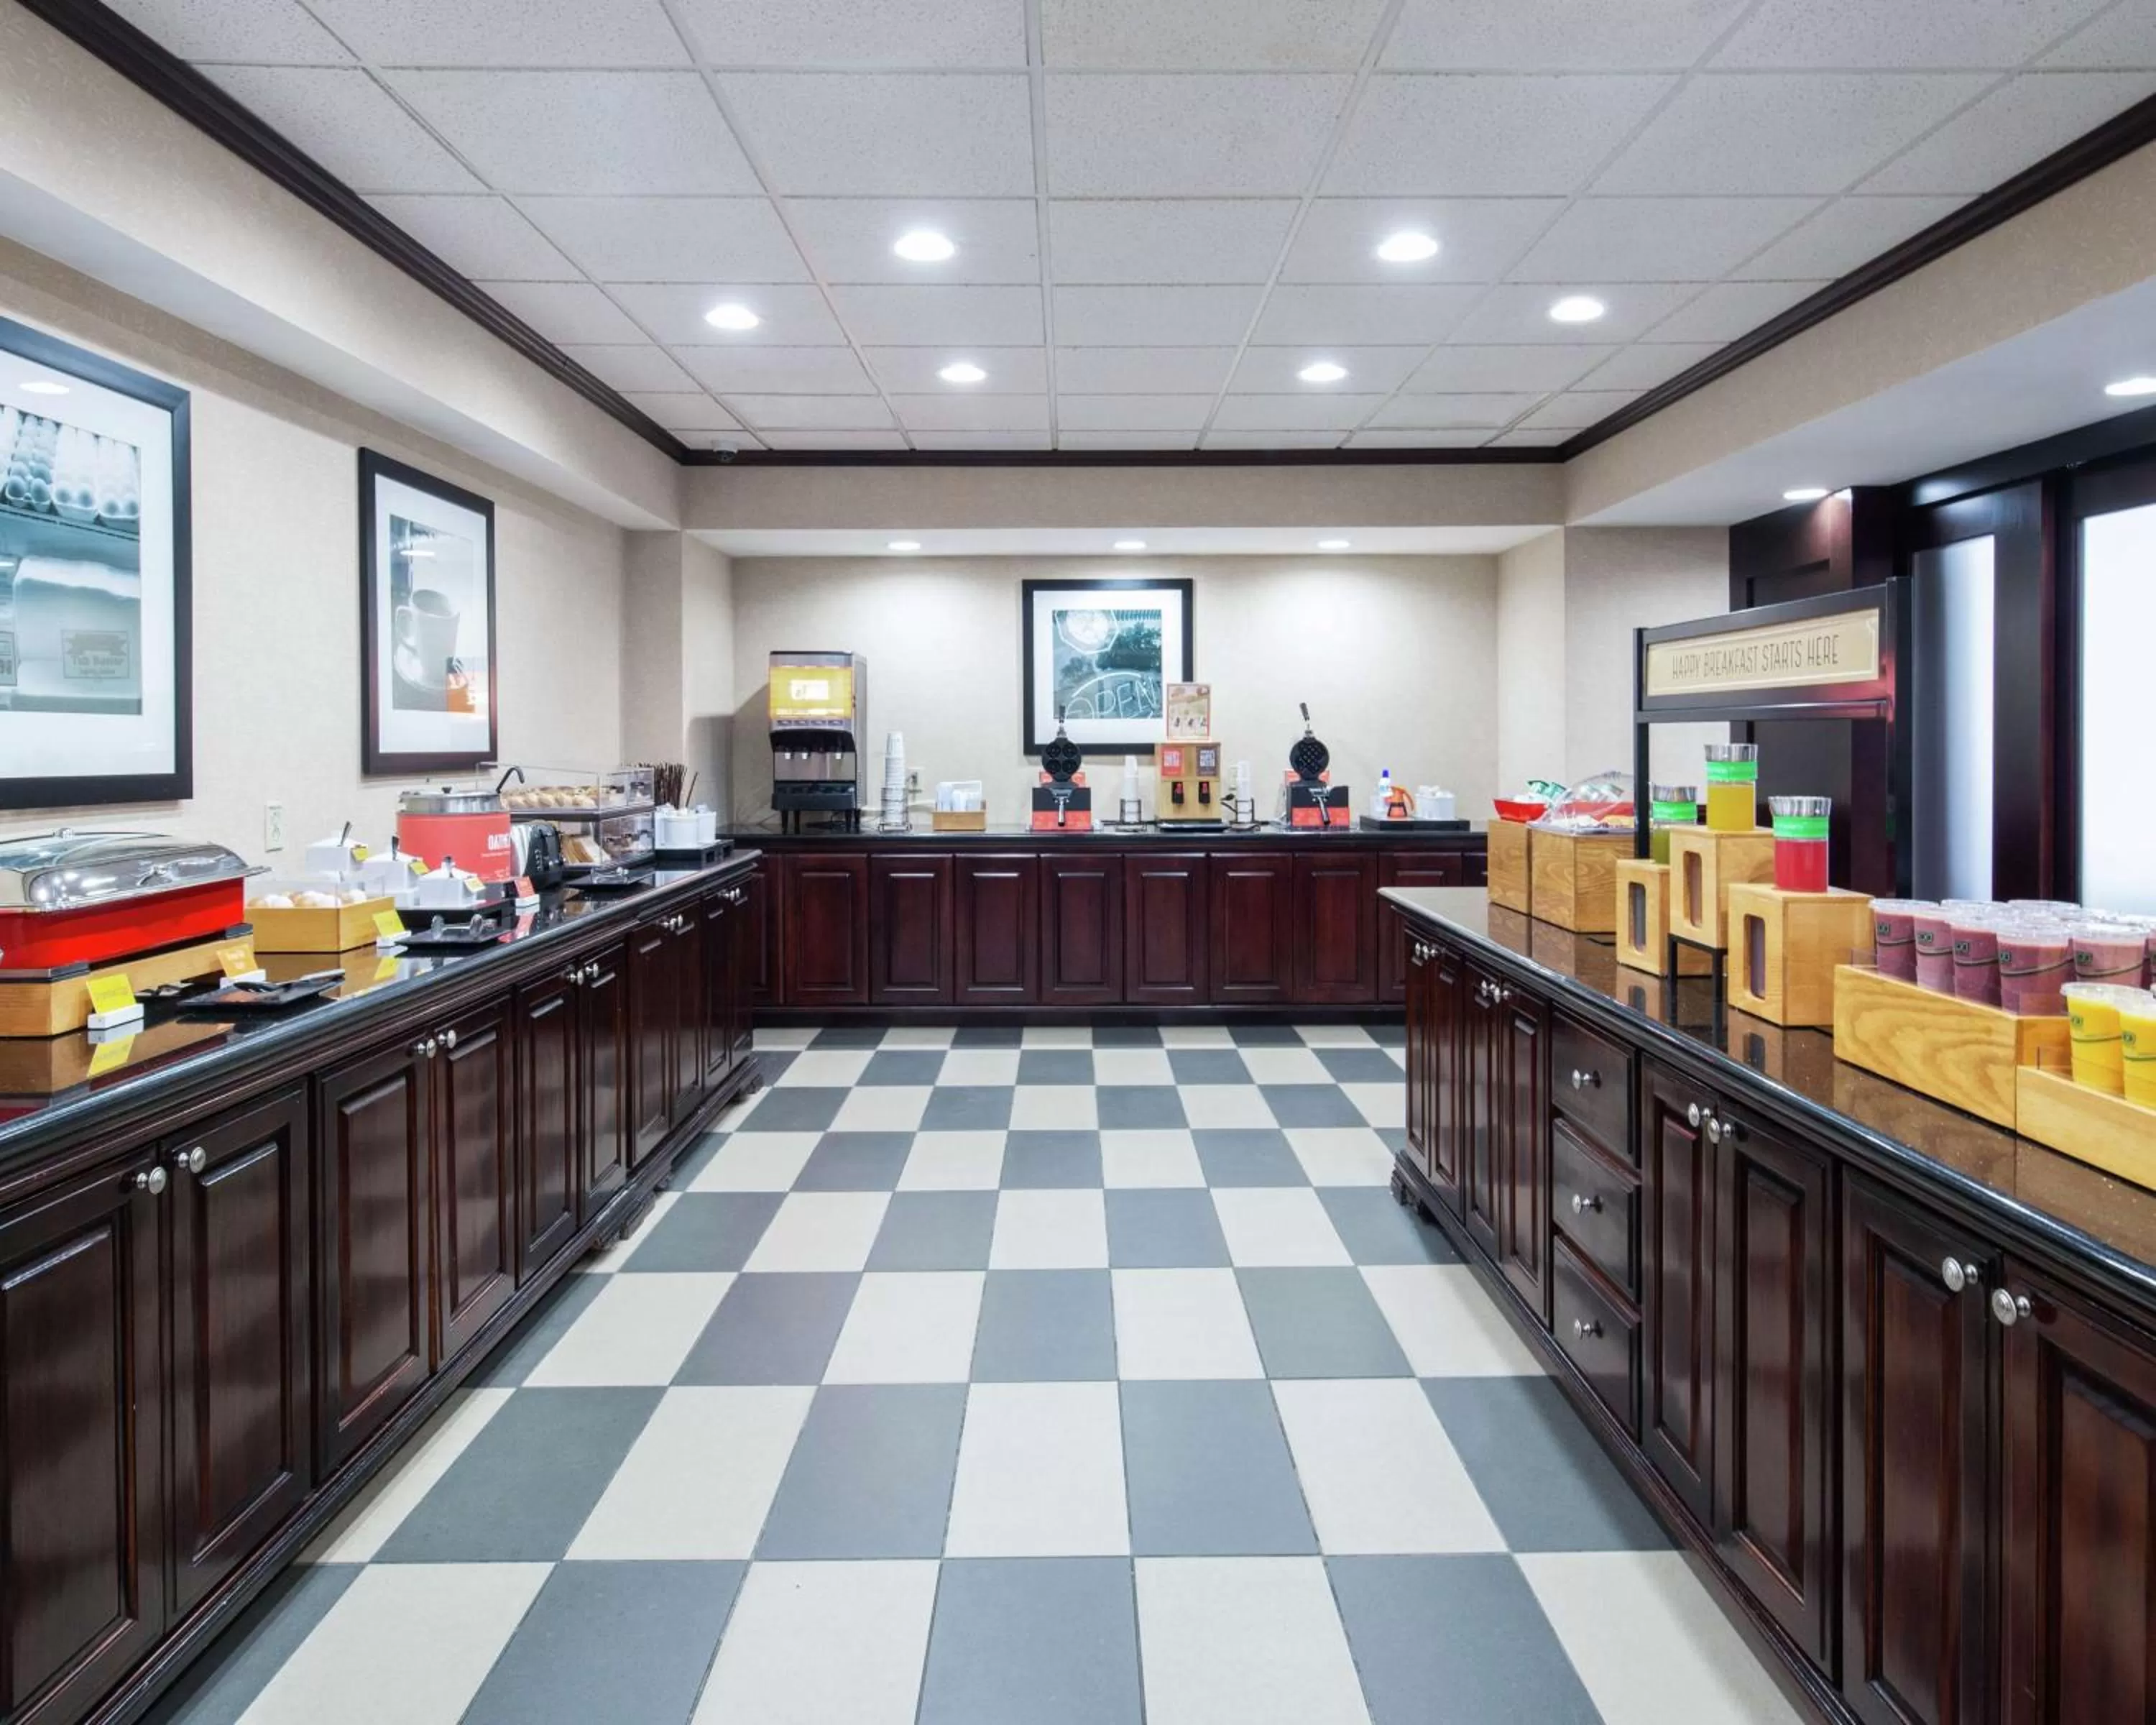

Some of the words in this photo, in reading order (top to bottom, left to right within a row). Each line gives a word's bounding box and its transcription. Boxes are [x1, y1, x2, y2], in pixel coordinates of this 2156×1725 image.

[1672, 655, 1701, 679] HAPPY
[1704, 646, 1759, 677] BREAKFAST
[1761, 639, 1802, 671] STARTS
[1807, 634, 1839, 666] HERE
[1066, 677, 1156, 719] OPEN
